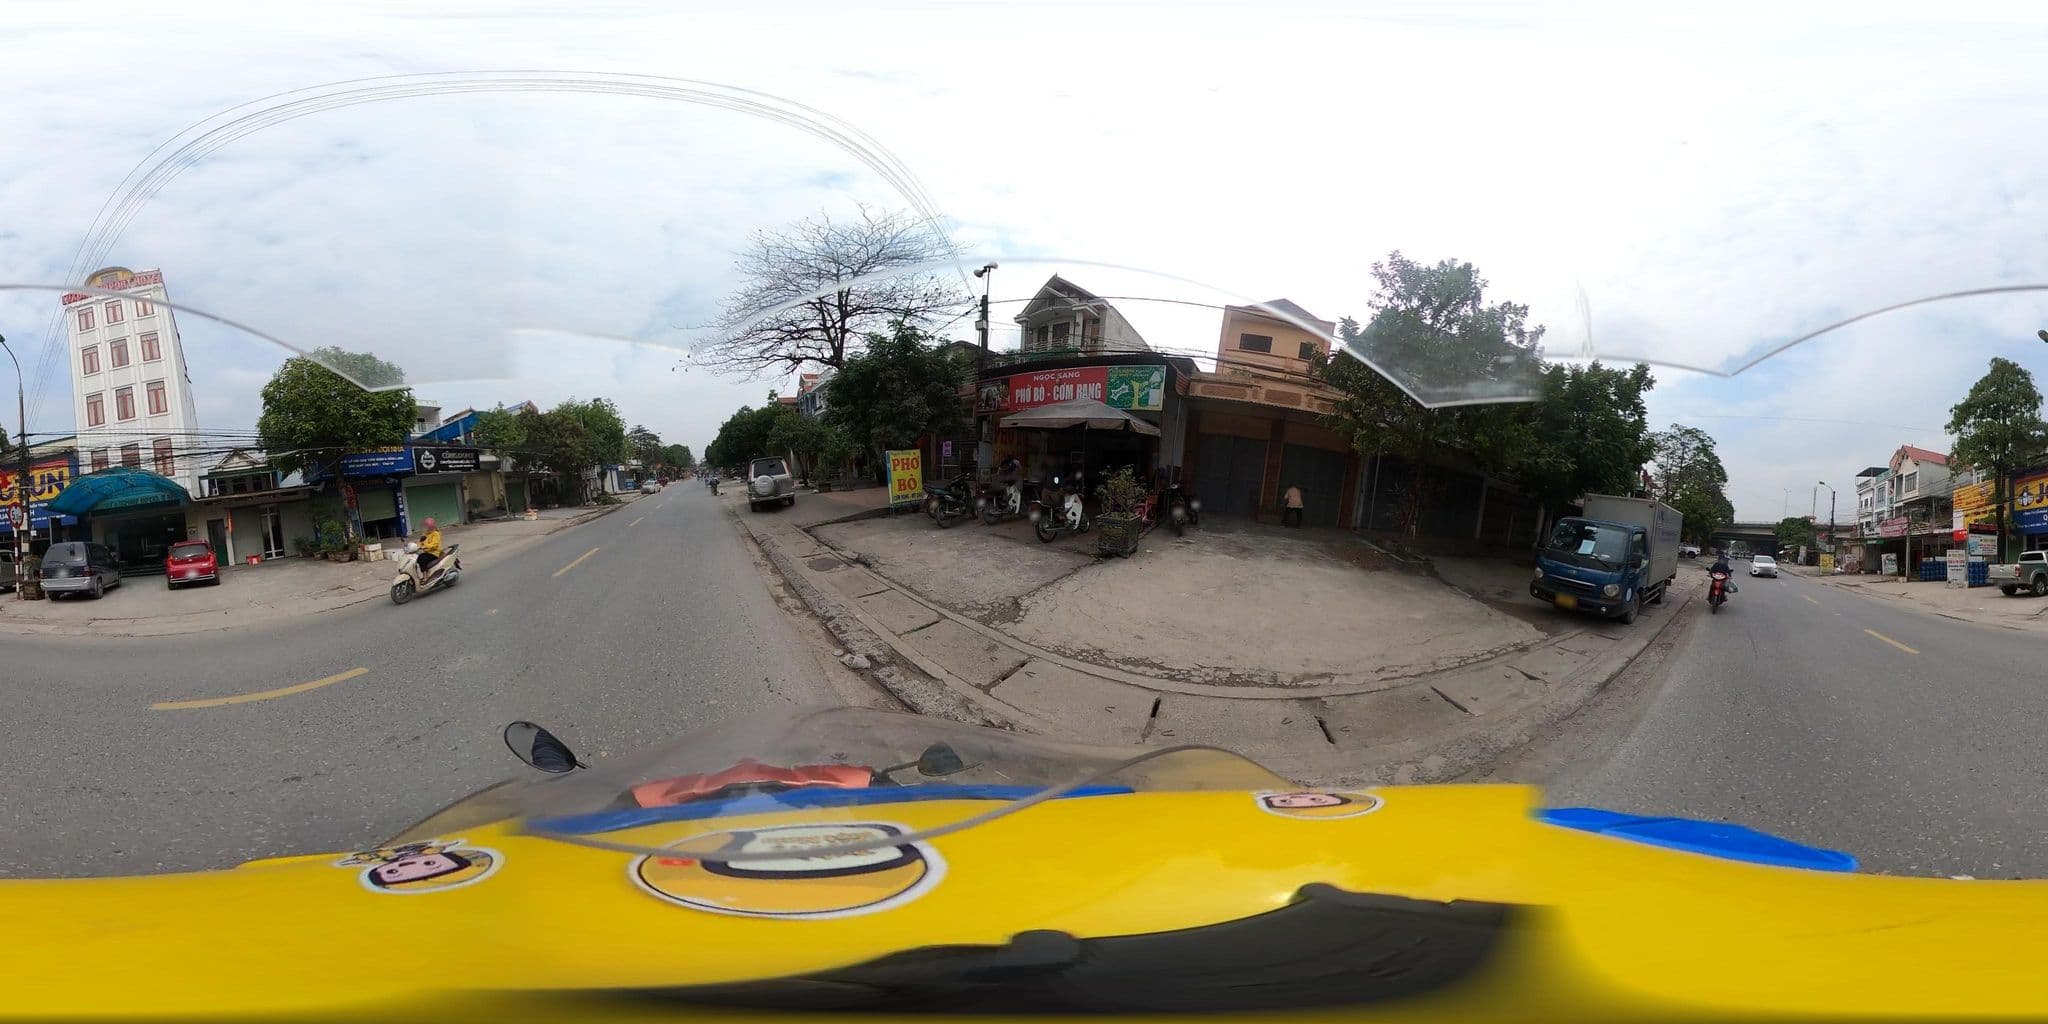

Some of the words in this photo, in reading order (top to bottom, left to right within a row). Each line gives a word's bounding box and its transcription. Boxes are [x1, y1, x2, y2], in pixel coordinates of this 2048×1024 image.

[1057, 371, 1081, 379] SANG
[1016, 384, 1031, 404] PHỞ
[1034, 384, 1045, 402] BÒ
[1053, 383, 1074, 401] CƠM
[1076, 382, 1102, 401] RANG
[892, 451, 920, 472] PHỞ
[897, 474, 918, 492] BÒ
